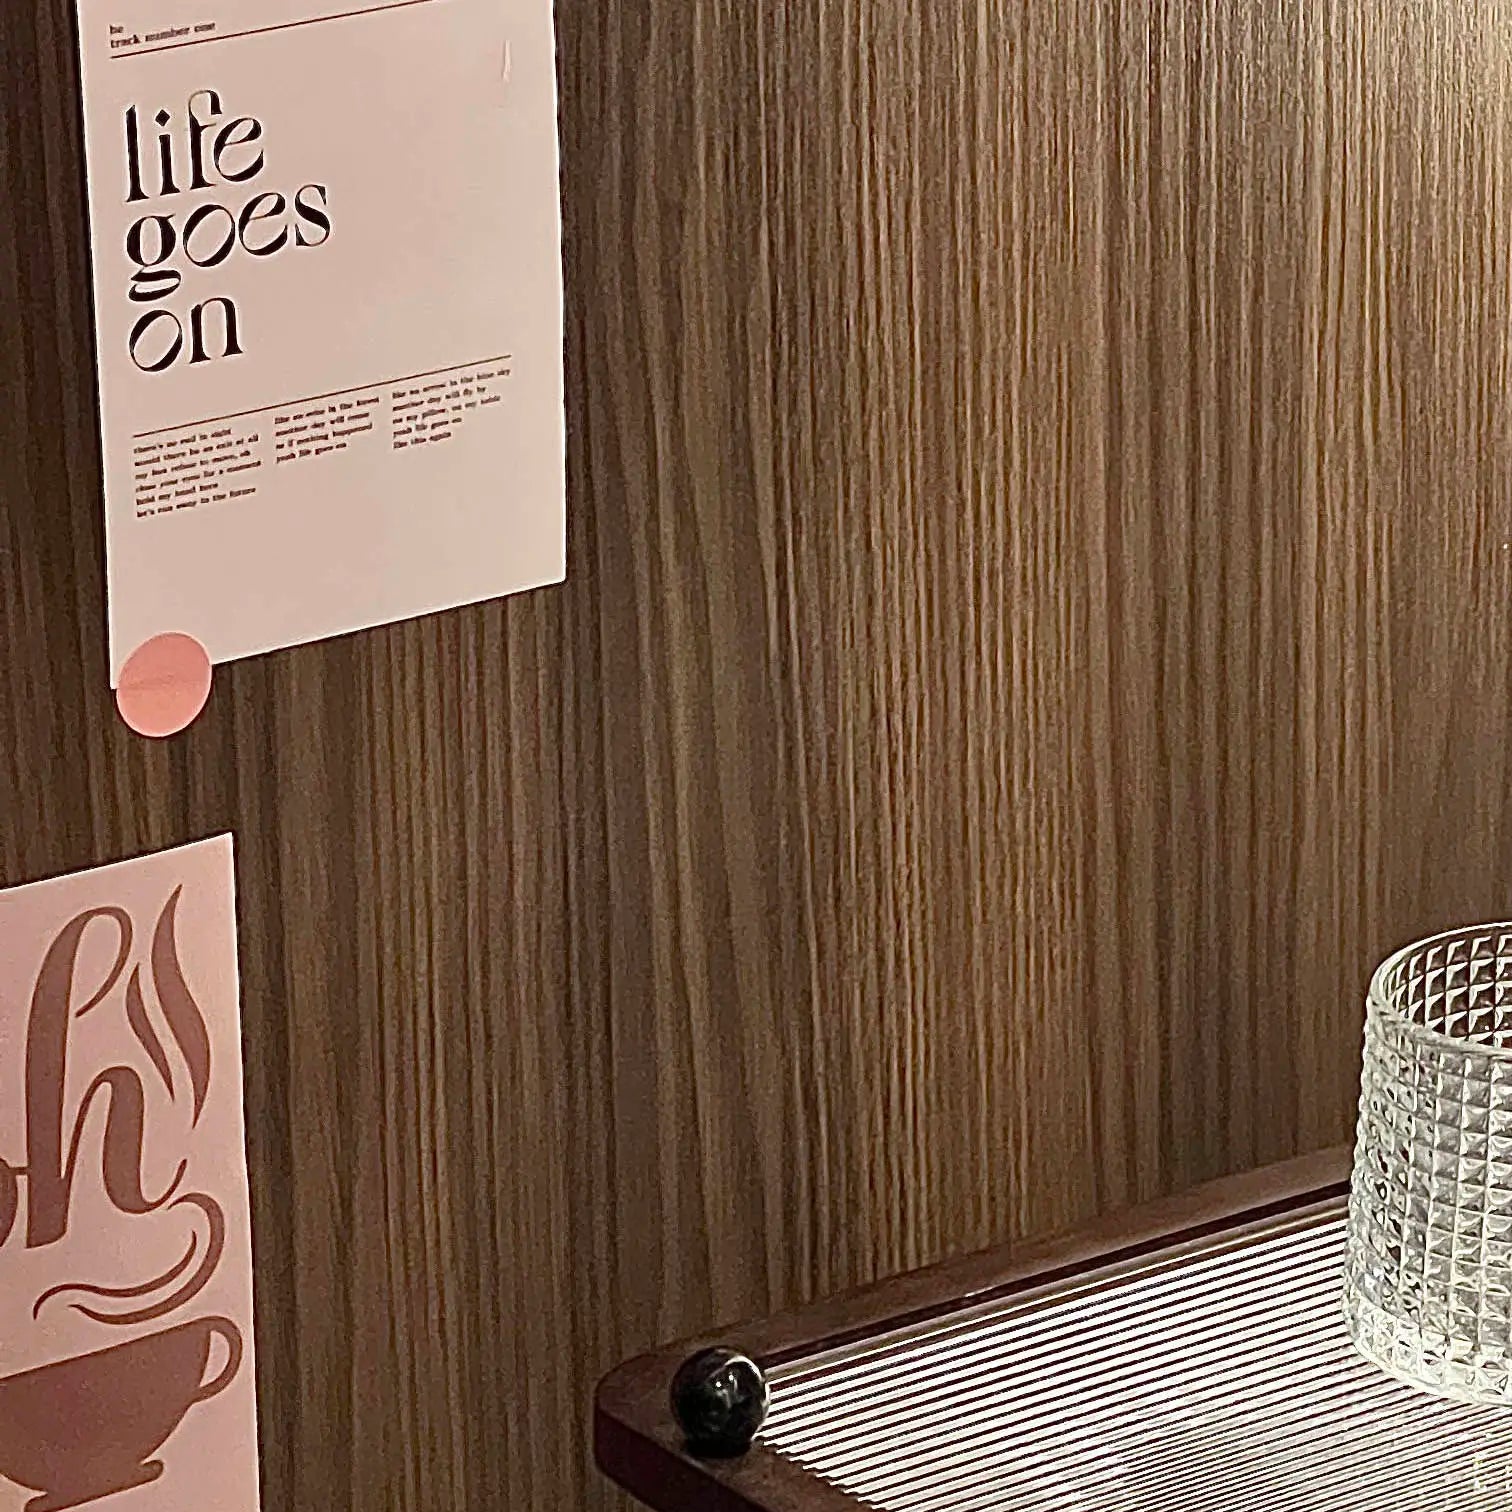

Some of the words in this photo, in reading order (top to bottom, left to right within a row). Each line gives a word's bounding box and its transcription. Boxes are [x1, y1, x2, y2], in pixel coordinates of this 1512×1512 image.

[125, 89, 264, 203] life
[126, 183, 331, 302] goes
[128, 297, 244, 373] on
